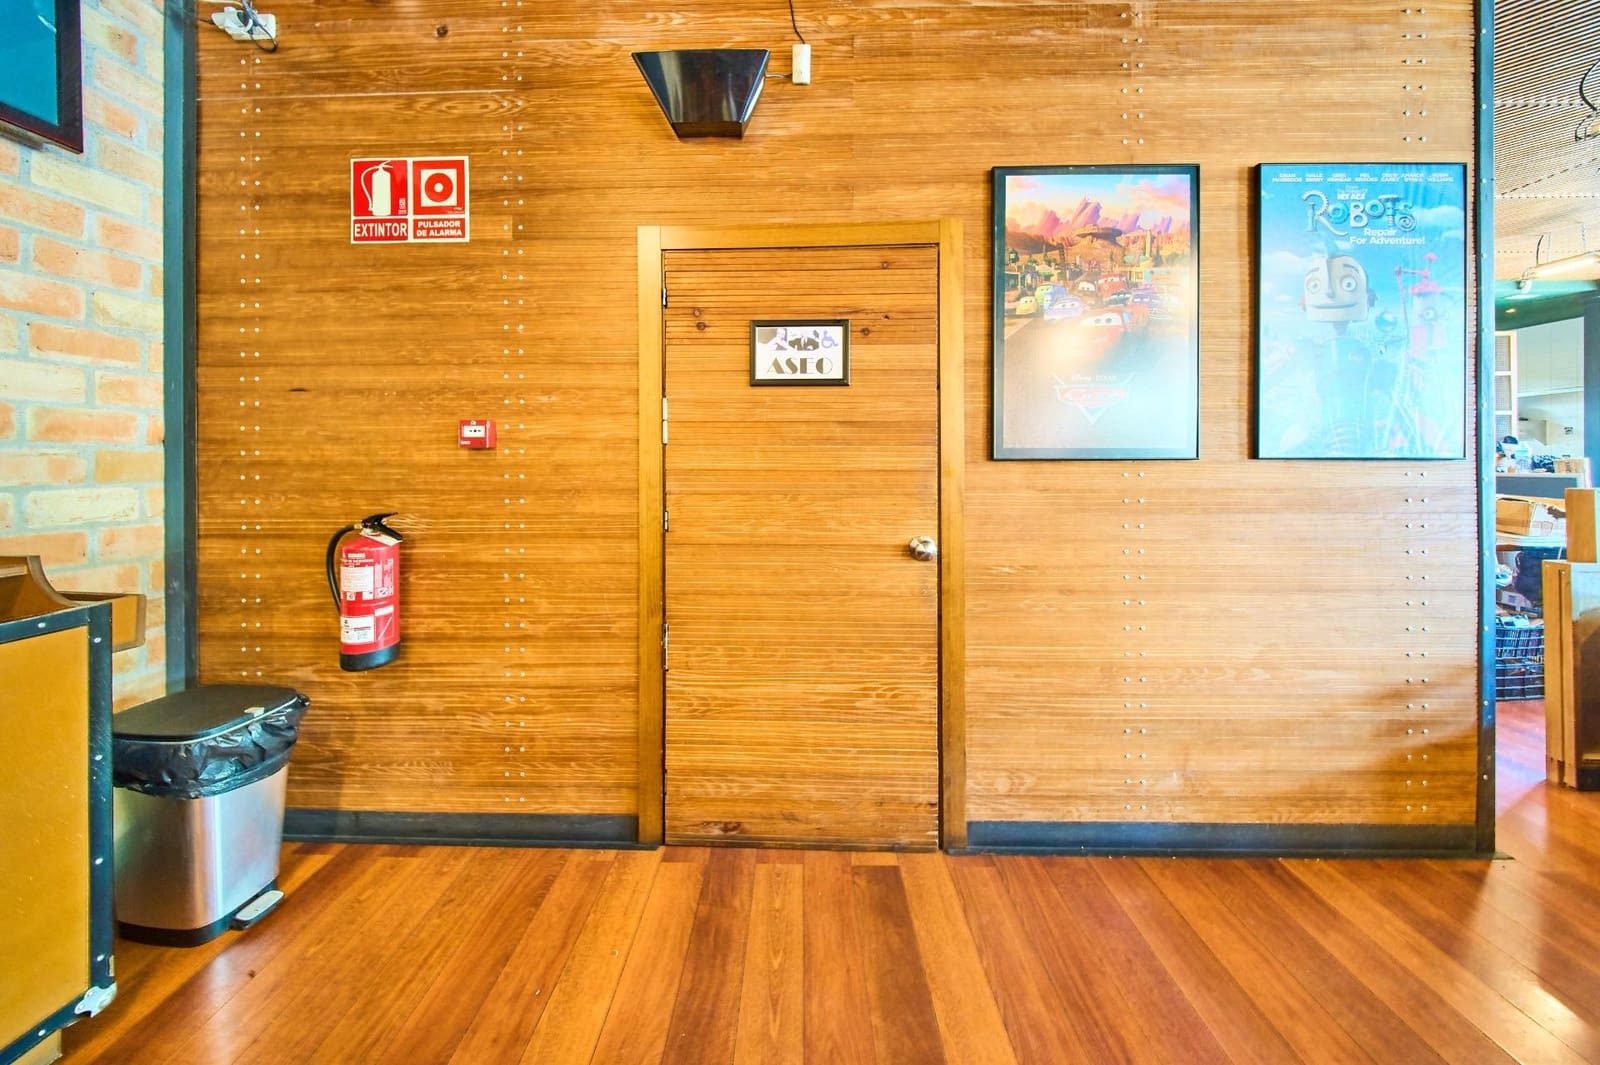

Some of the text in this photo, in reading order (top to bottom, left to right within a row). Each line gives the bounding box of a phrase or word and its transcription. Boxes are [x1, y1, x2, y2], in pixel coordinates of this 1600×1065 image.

[1301, 189, 1417, 236] ROBOTS
[354, 222, 407, 237] EXTINTOR
[418, 220, 461, 228] PULSADOR
[416, 229, 462, 237] DE ALARMA
[1364, 228, 1397, 239] Repair
[1349, 235, 1425, 245] For Adventure!
[766, 357, 834, 375] ASEO
